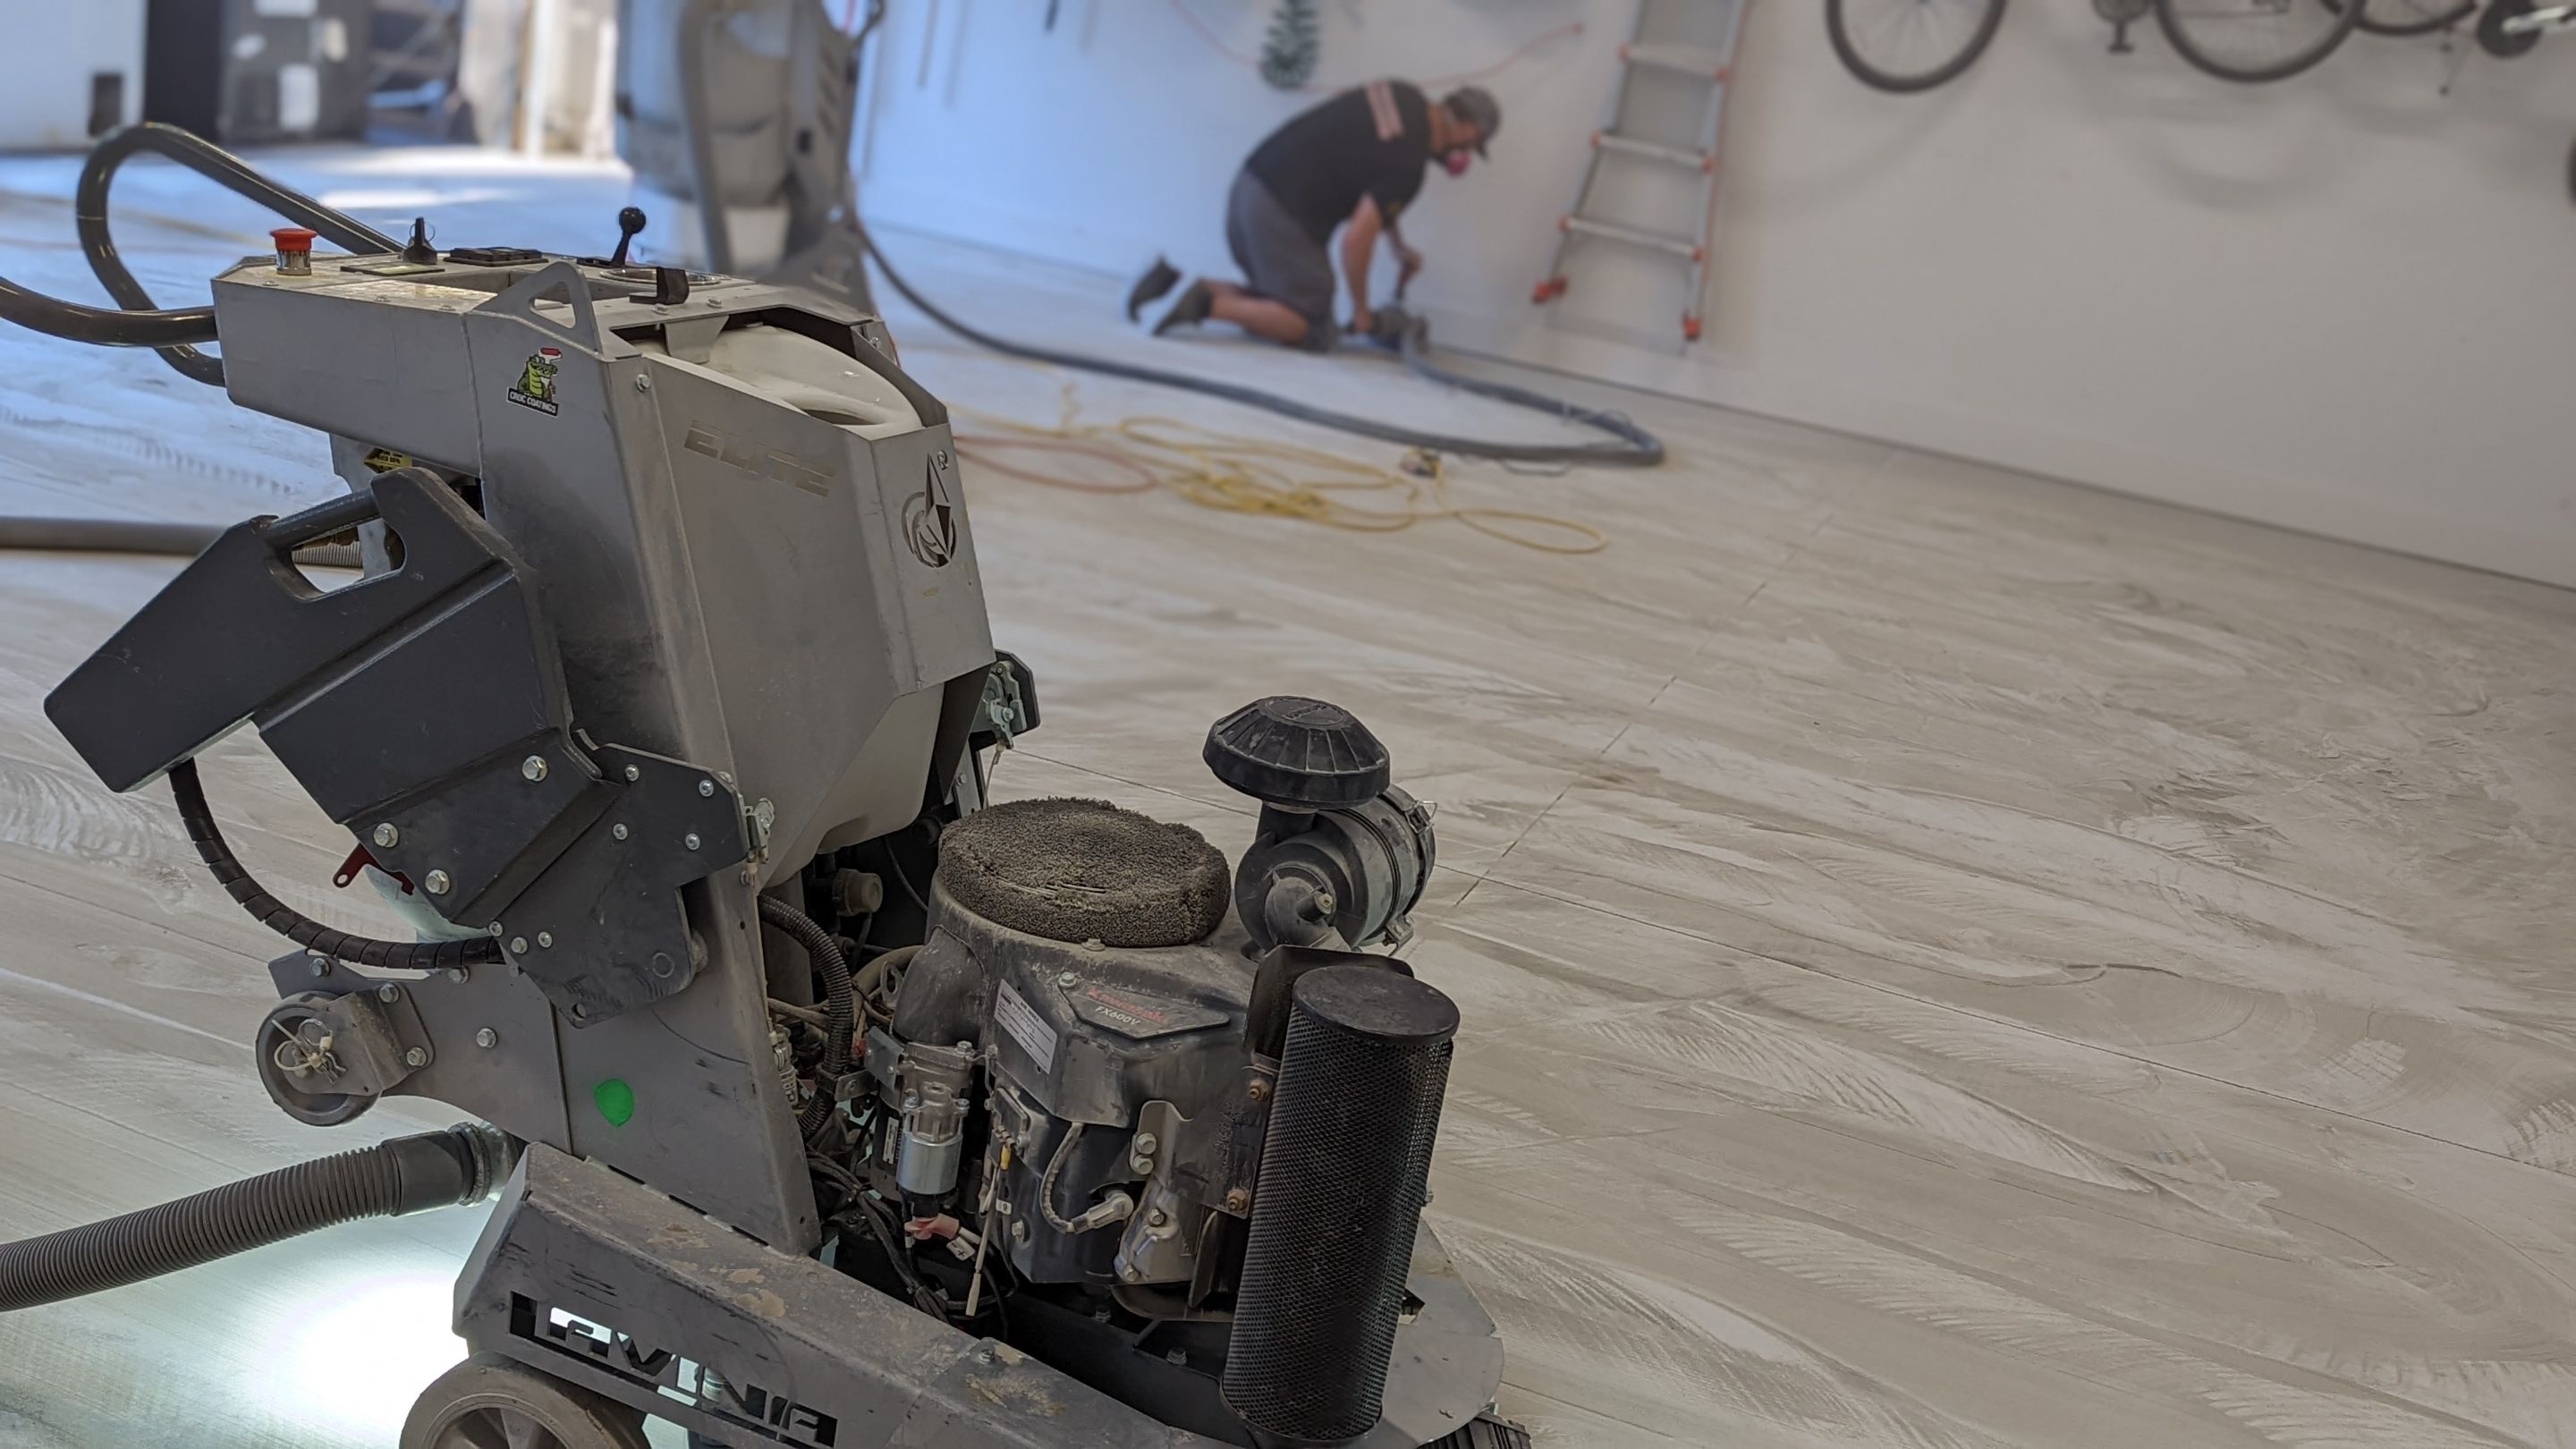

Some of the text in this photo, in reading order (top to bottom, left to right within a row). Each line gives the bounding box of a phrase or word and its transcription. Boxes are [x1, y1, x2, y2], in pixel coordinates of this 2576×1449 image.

[683, 419, 835, 497] ELITE
[1095, 1005, 1141, 1025] FX600V
[509, 1291, 838, 1449] LAVINA
